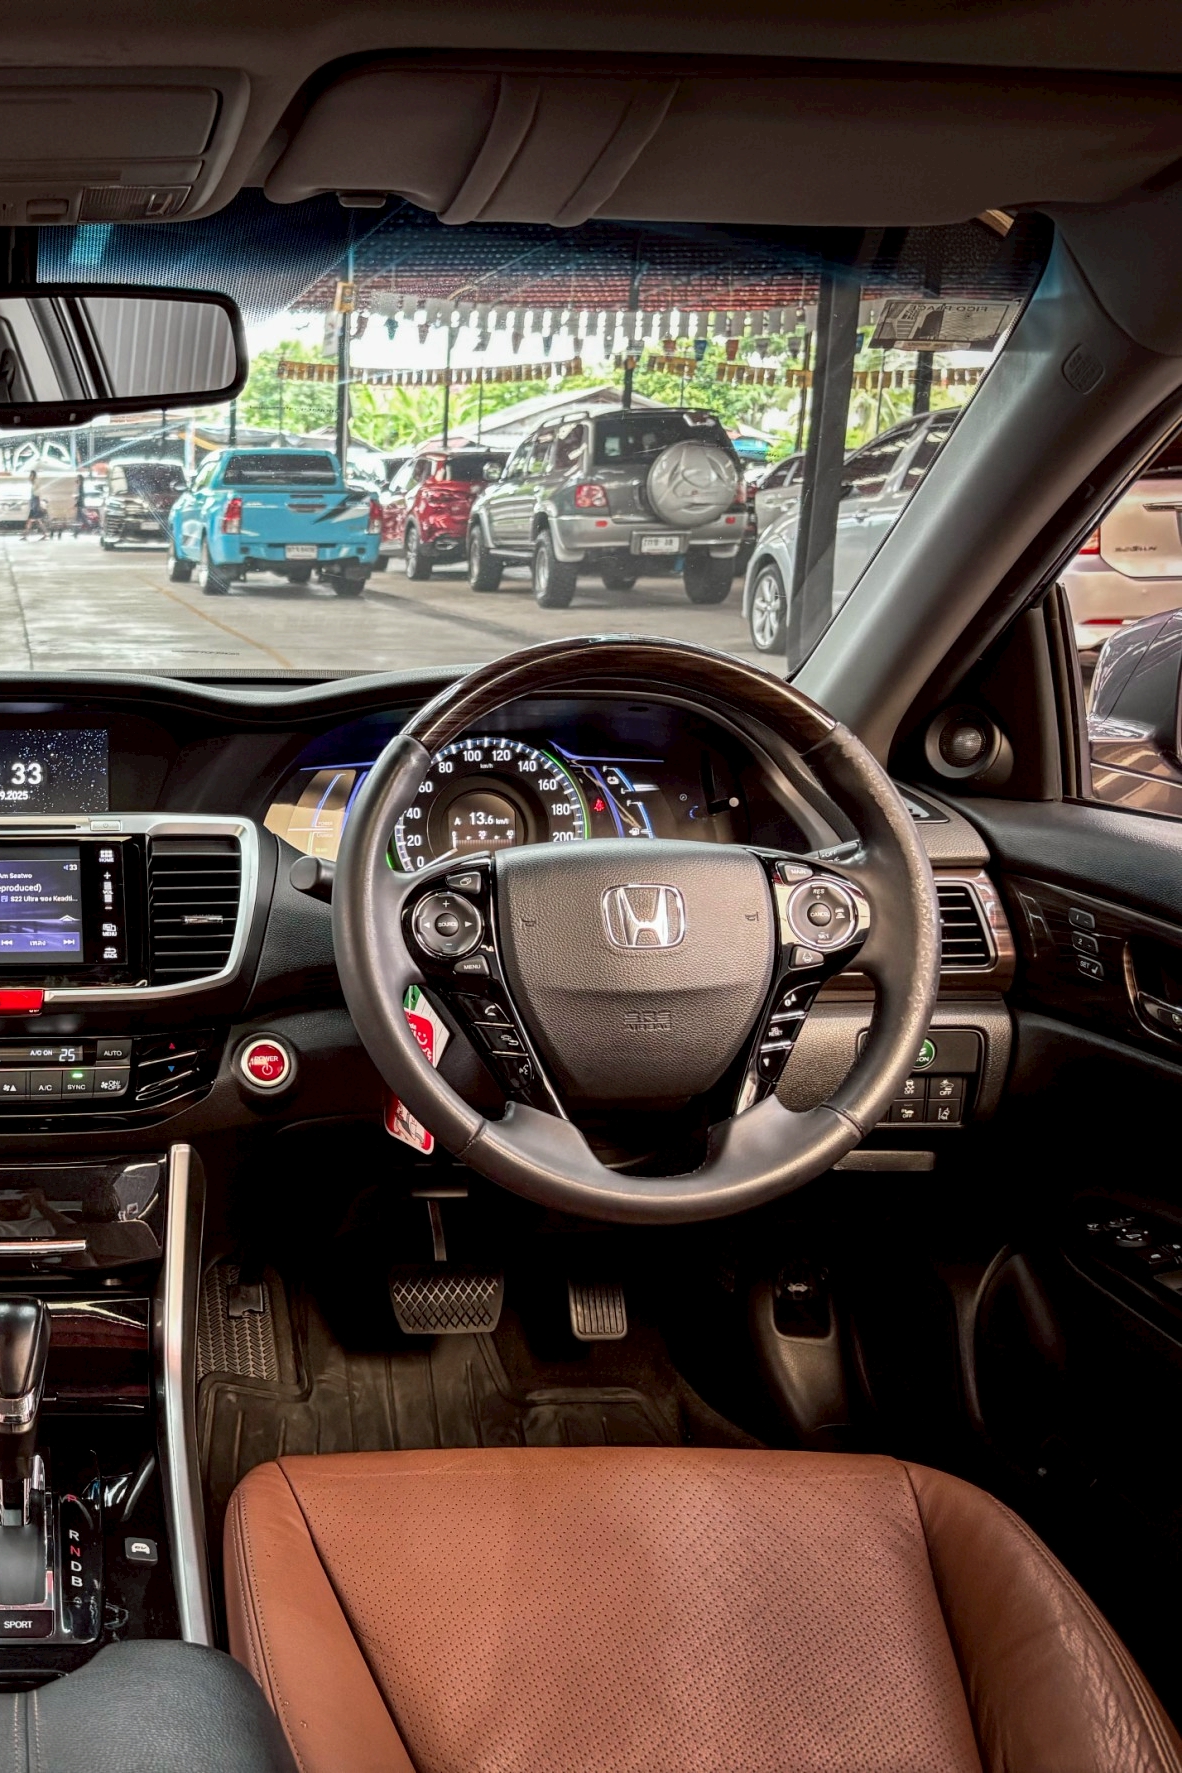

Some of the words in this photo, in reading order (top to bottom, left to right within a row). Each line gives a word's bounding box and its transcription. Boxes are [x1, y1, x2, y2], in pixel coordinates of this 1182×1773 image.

[463, 750, 482, 762] 100
[492, 749, 511, 762] 120
[438, 761, 453, 773] 80
[518, 760, 537, 773] 140
[11, 762, 44, 786] 33
[418, 781, 433, 793] 60
[537, 778, 557, 791] 160
[406, 807, 421, 820] 40
[550, 803, 570, 816] 180
[469, 811, 495, 826] 13.6
[406, 834, 422, 847] 20
[552, 832, 573, 842] 200
[417, 856, 425, 868] 0
[58, 1048, 76, 1062] 25
[69, 1529, 80, 1541] R
[70, 1545, 81, 1557] N
[71, 1560, 82, 1572] D
[71, 1575, 83, 1587] B
[3, 1619, 33, 1630] SPORT
